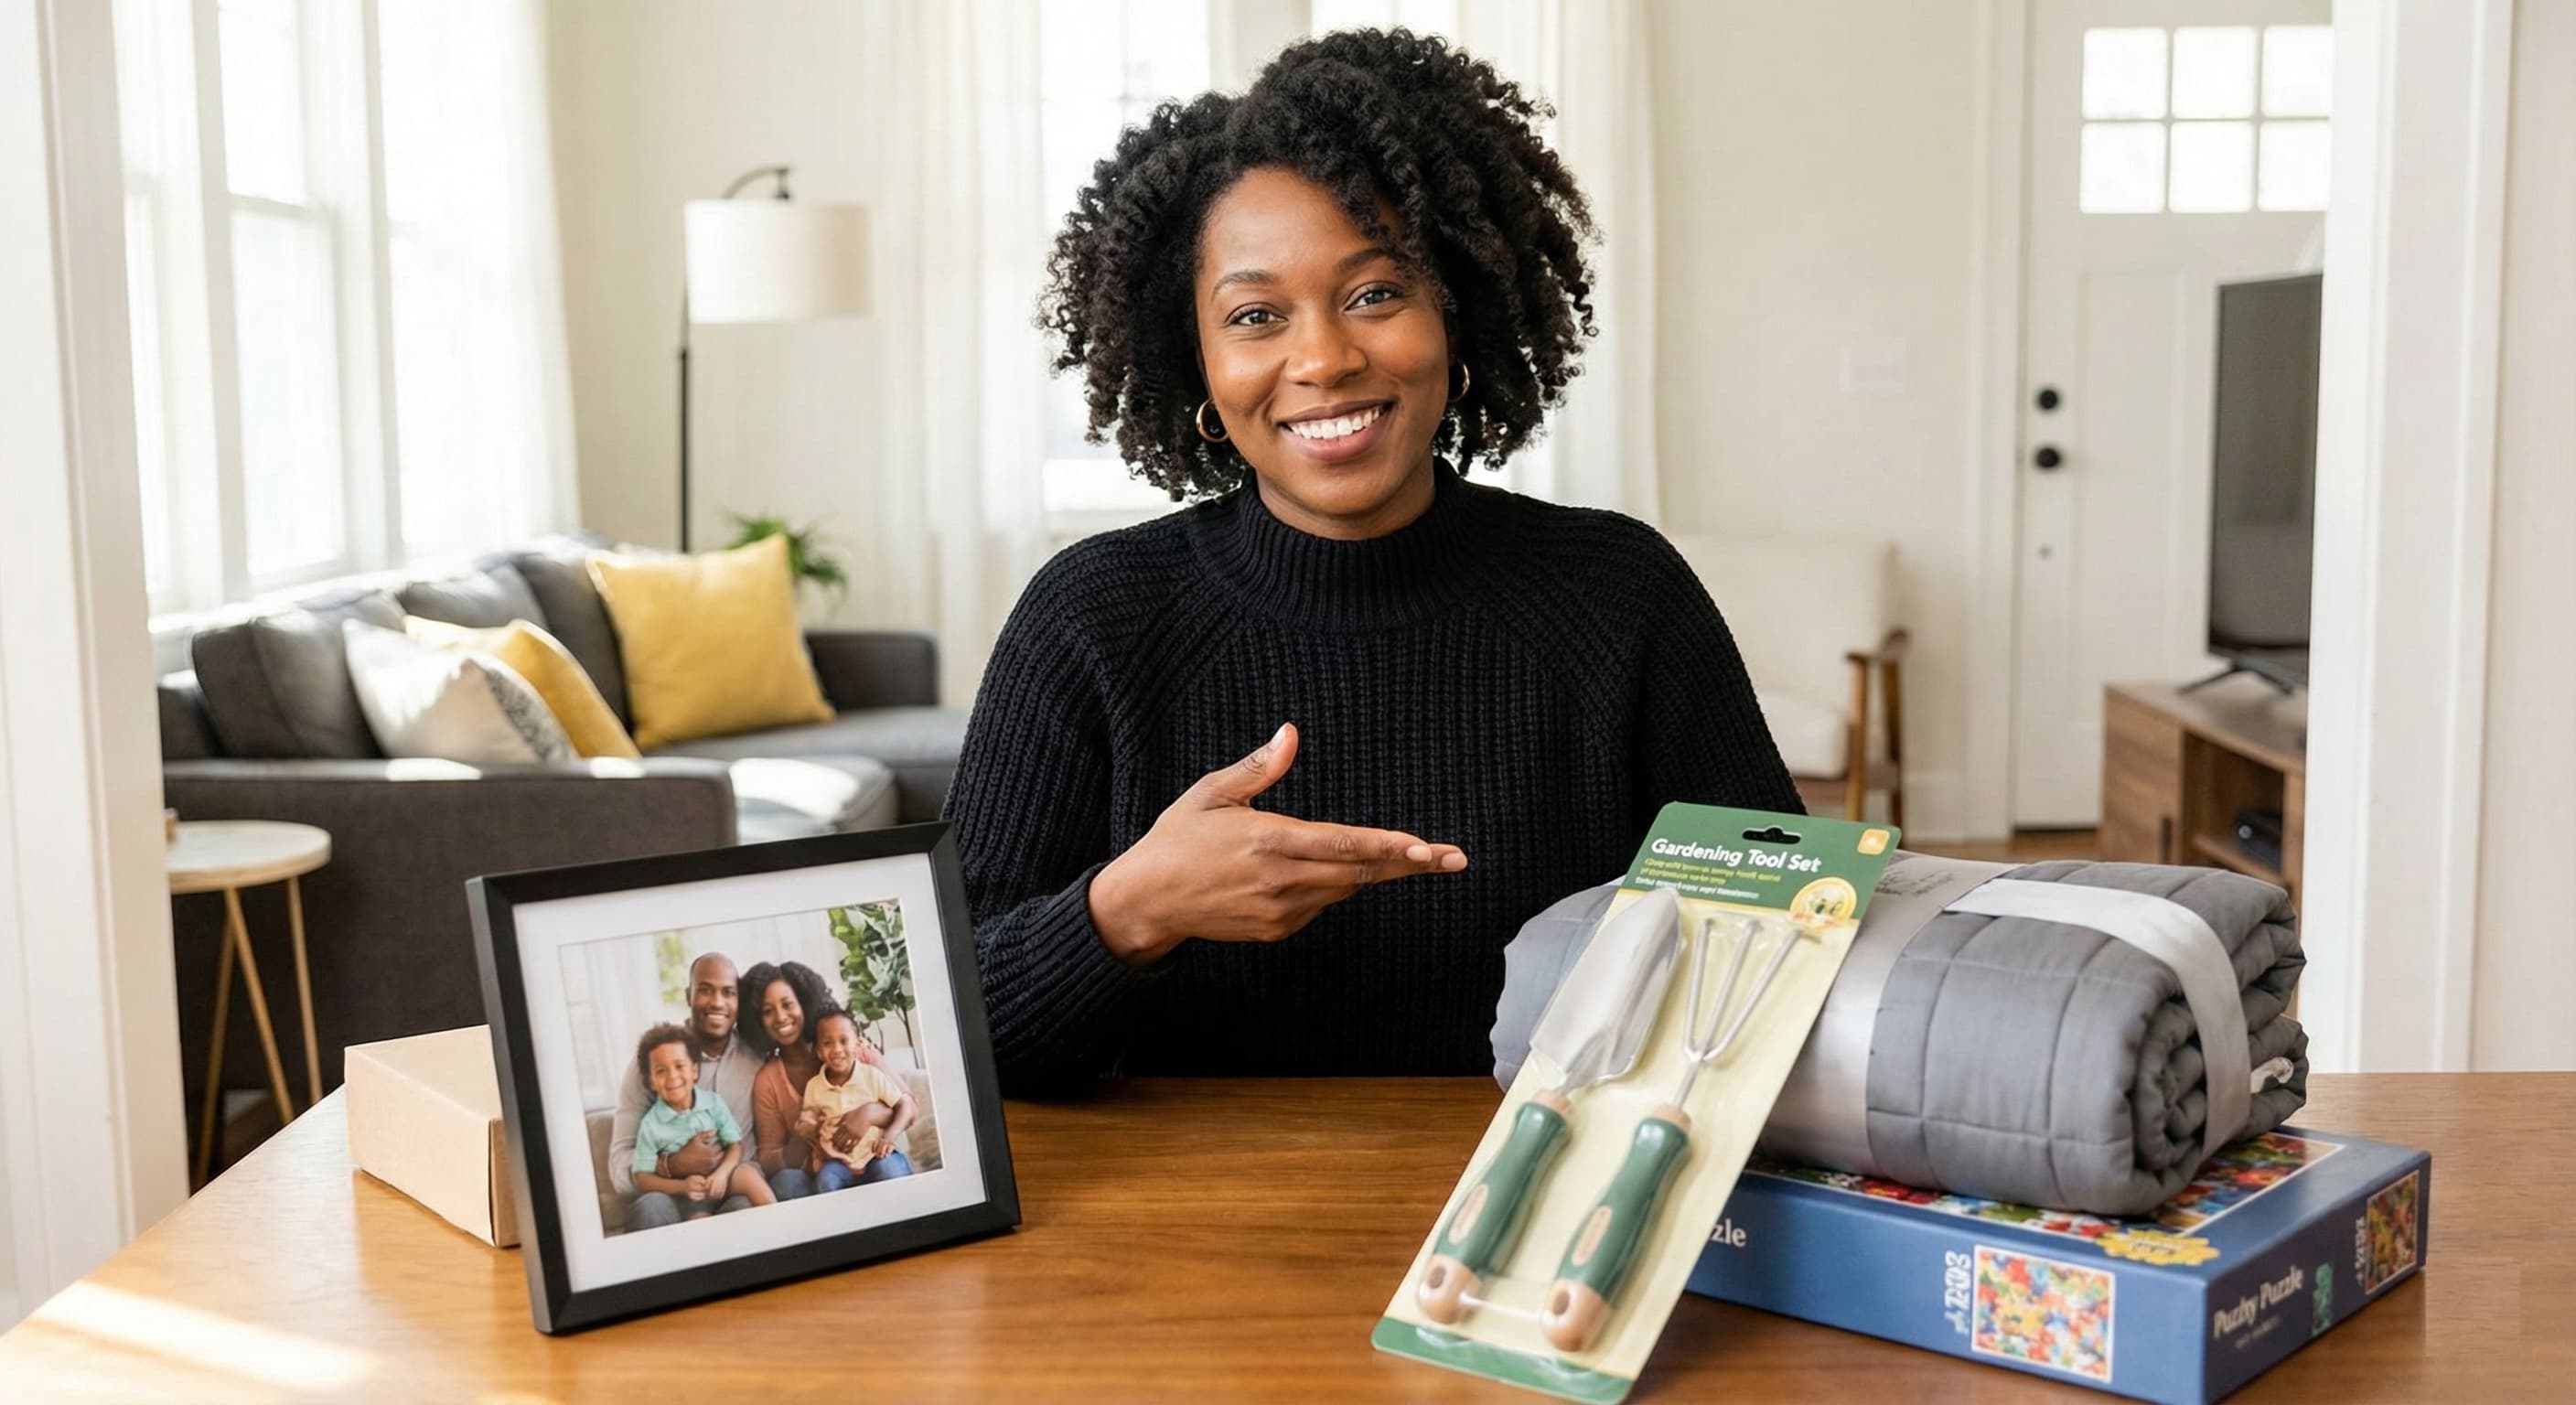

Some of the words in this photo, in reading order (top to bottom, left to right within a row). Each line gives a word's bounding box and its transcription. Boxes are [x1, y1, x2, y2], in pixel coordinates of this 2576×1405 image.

[1651, 838, 1743, 867] Gardening
[1747, 849, 1787, 868] Tool
[1787, 853, 1822, 873] Set
